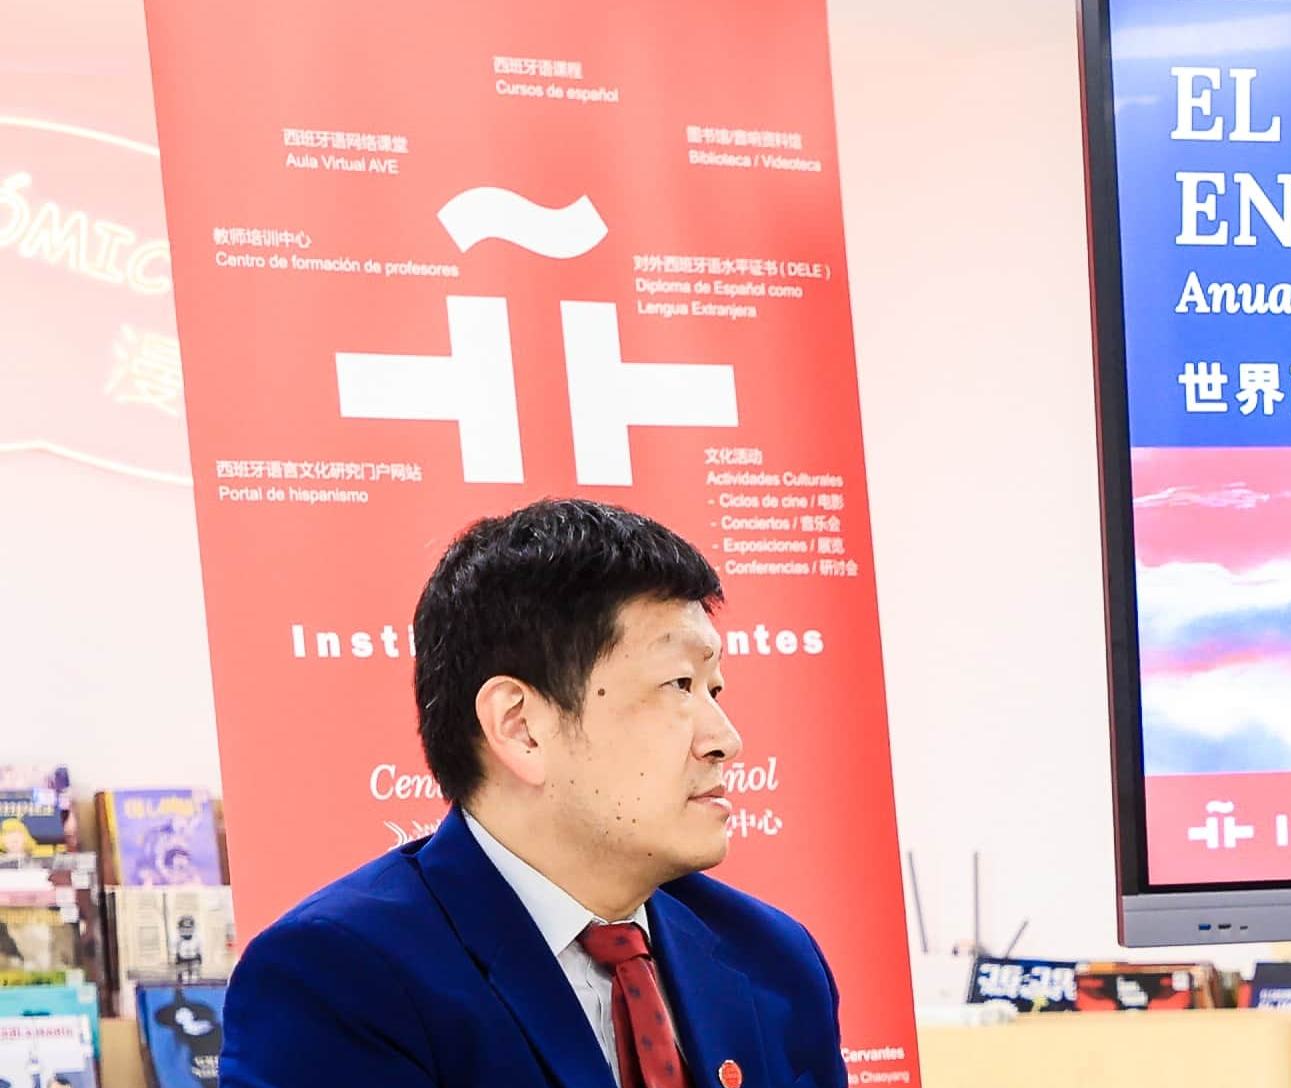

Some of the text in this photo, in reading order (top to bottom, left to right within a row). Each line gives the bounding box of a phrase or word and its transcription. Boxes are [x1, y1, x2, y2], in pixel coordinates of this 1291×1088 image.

[496, 79, 619, 103] Cursos de español
[1170, 66, 1281, 144] EL
[286, 153, 399, 174] Aula Virtual AVE
[689, 150, 751, 168] Biblioteca
[761, 154, 821, 172] Videoteca
[215, 252, 459, 277] Centro de formación de profesores
[635, 277, 803, 299] Diploma de Español como
[637, 300, 757, 320] Lengua Extranjera
[706, 471, 844, 487] Actividades Culturales
[218, 485, 369, 505] Portal de hispanismo
[719, 493, 759, 508] Ciclos
[762, 494, 779, 508] de
[781, 495, 807, 508] cine
[721, 515, 790, 530] Conciertos
[723, 537, 807, 554] Exposiciones
[725, 559, 810, 575] Conferencias
